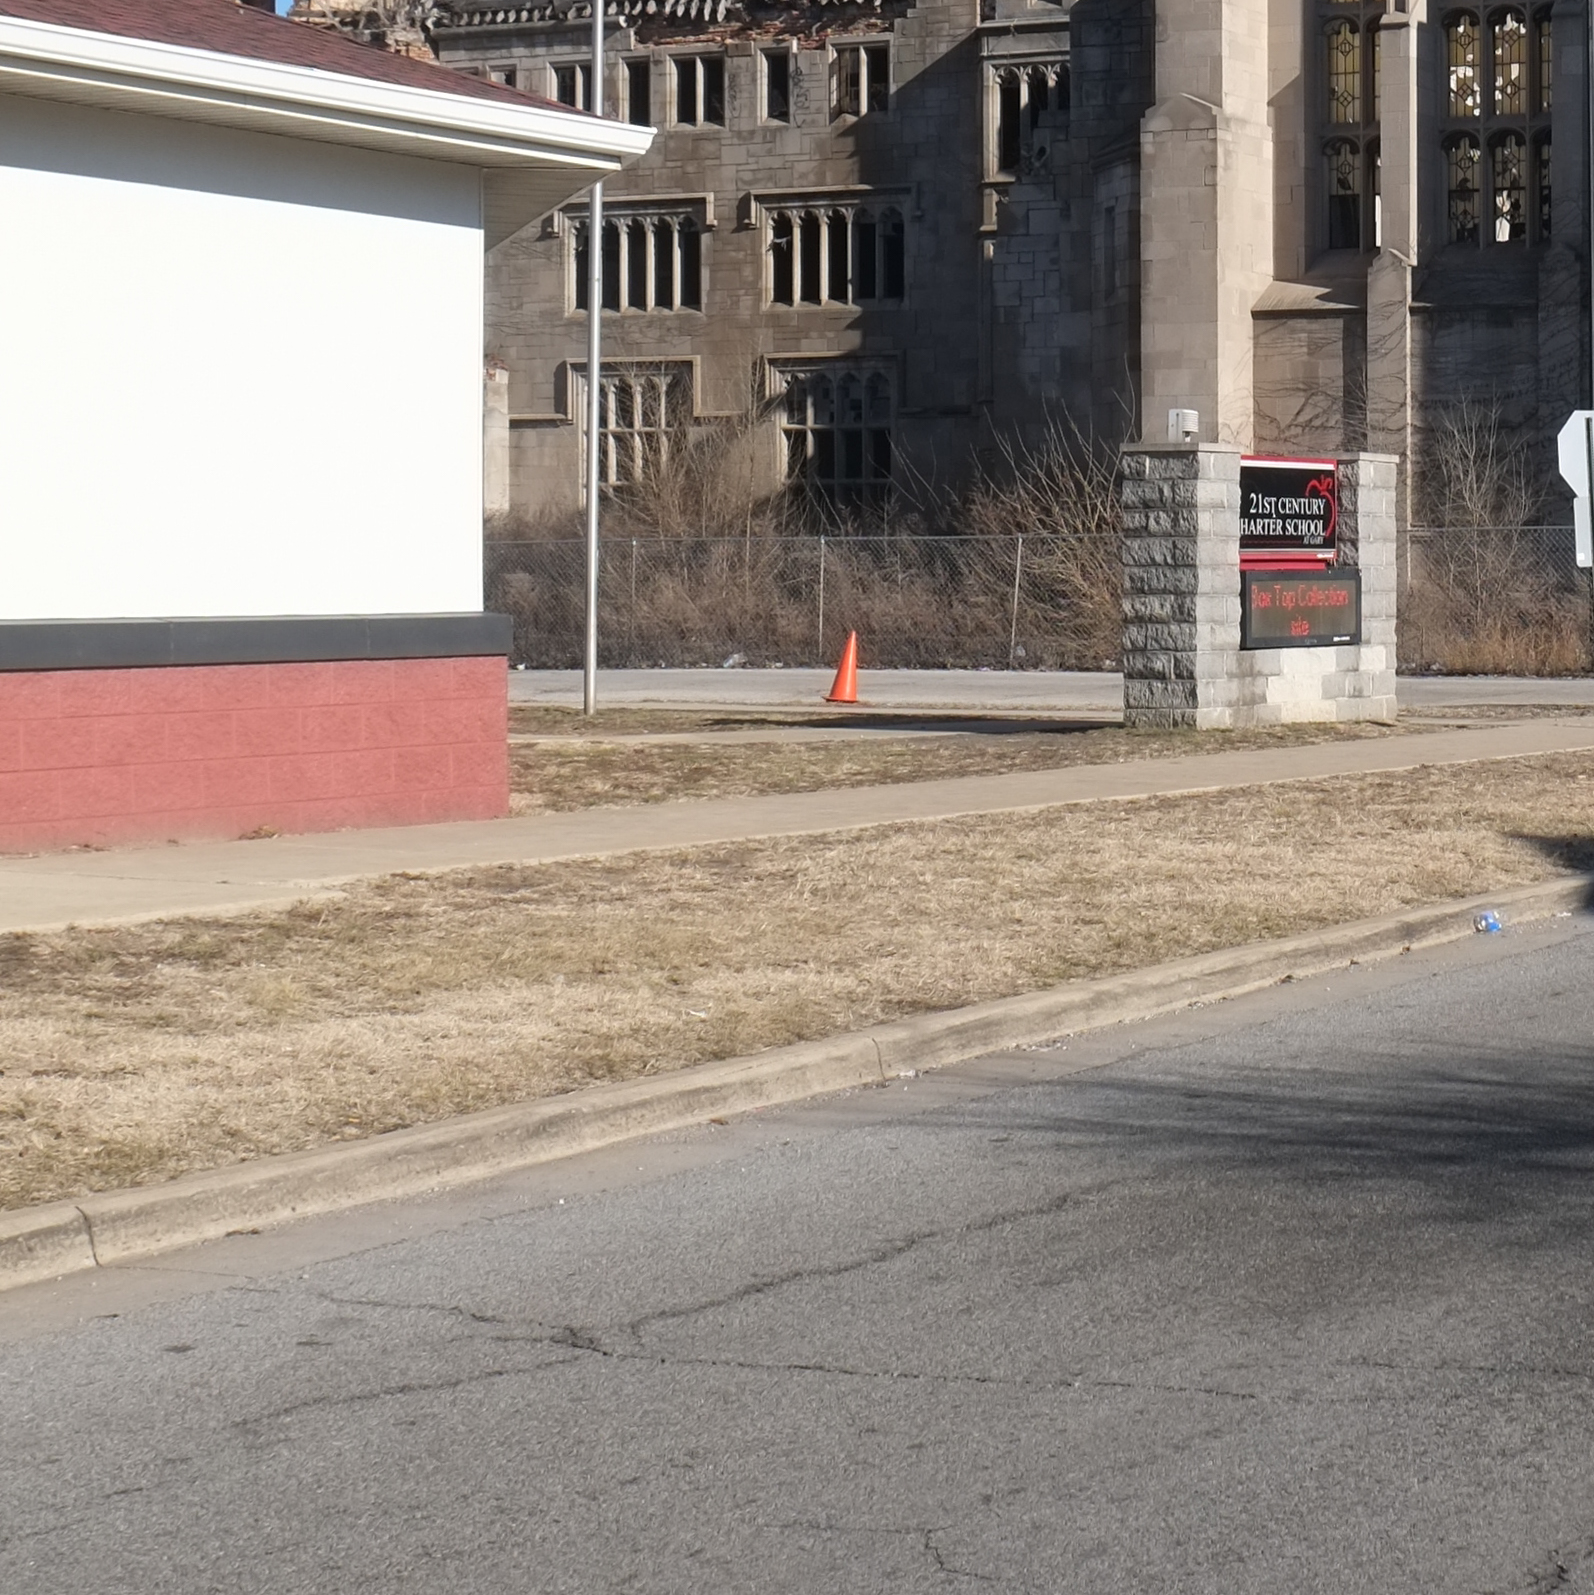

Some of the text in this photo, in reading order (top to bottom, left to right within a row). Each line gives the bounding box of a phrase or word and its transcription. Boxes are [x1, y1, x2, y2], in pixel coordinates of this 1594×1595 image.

[1249, 492, 1327, 518] 21ST CENTURY
[1240, 517, 1326, 537] HARTER SCHOOL
[1303, 536, 1310, 545] AT
[1310, 536, 1324, 545] GARY
[1274, 585, 1296, 610] Top
[1298, 584, 1349, 607] Collection
